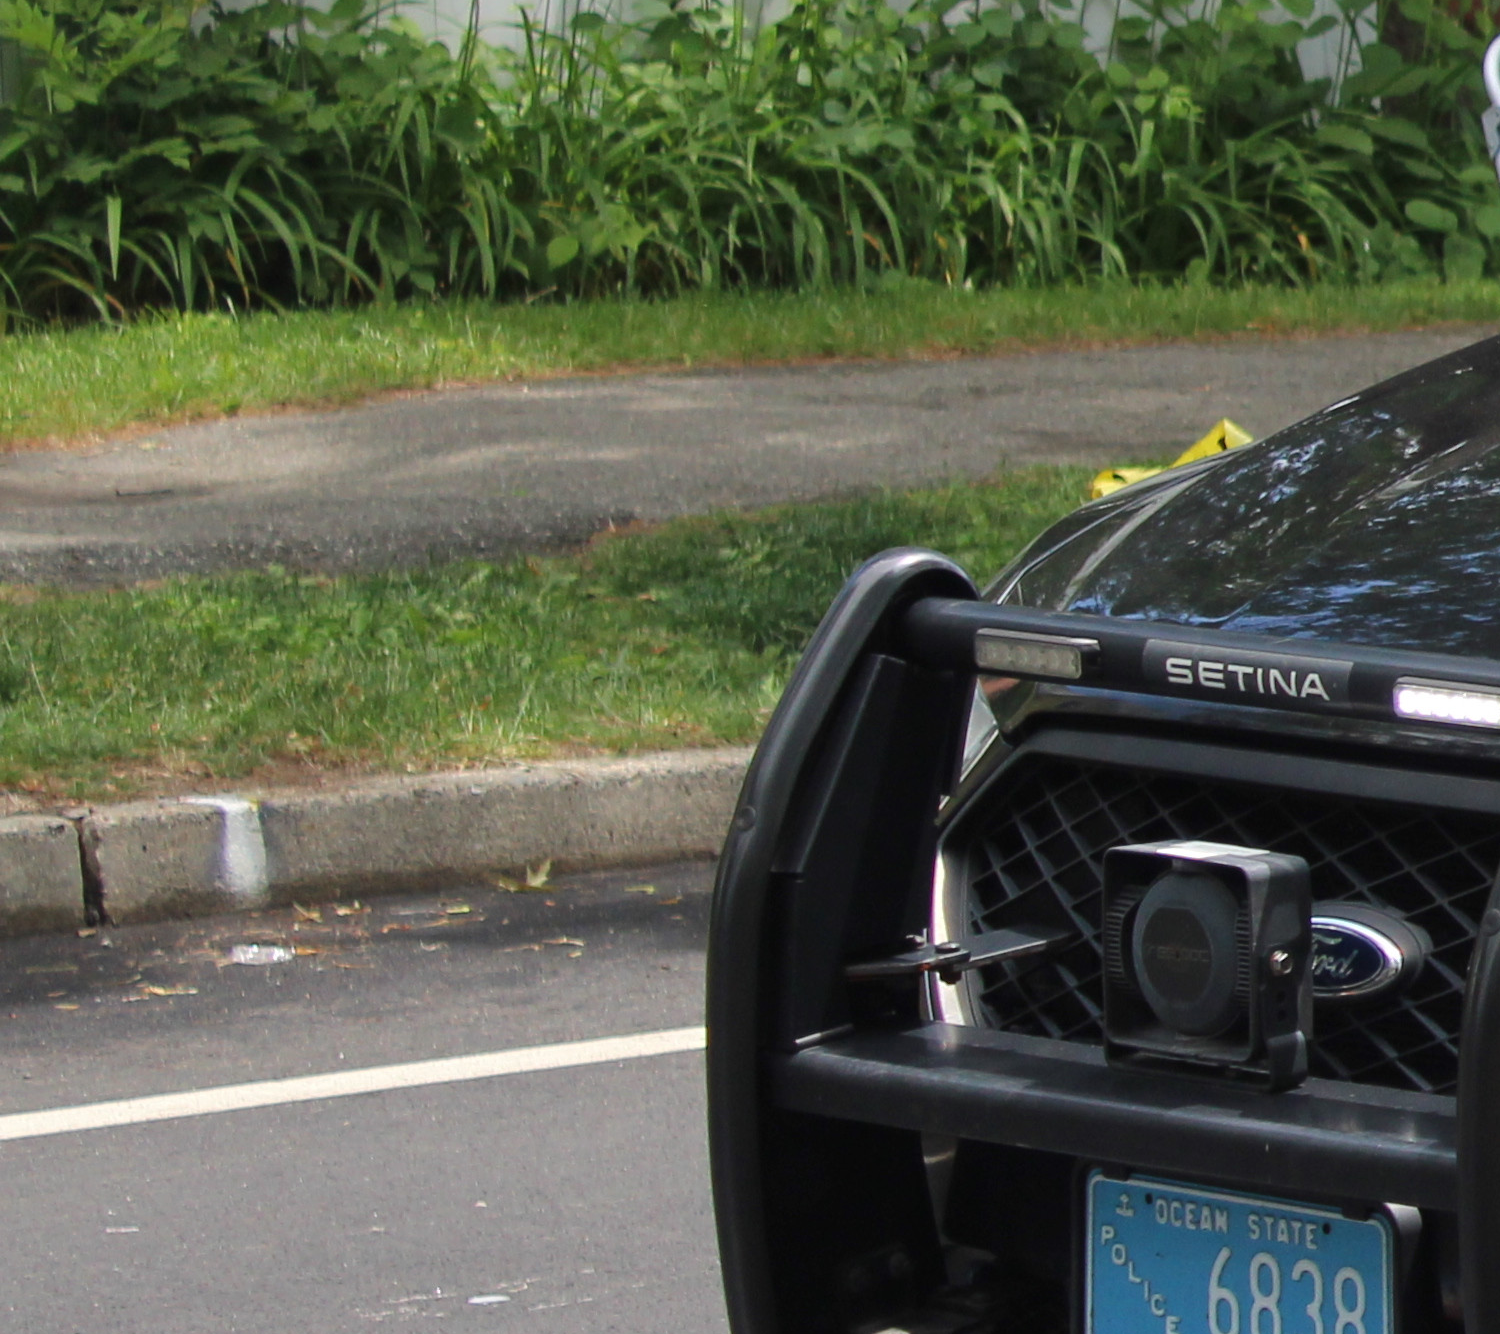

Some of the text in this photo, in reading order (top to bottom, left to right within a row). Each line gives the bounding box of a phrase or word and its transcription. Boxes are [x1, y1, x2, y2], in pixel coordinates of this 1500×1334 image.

[1165, 657, 1330, 701] SETINA
[1154, 1198, 1319, 1250] OCEAN STATE
